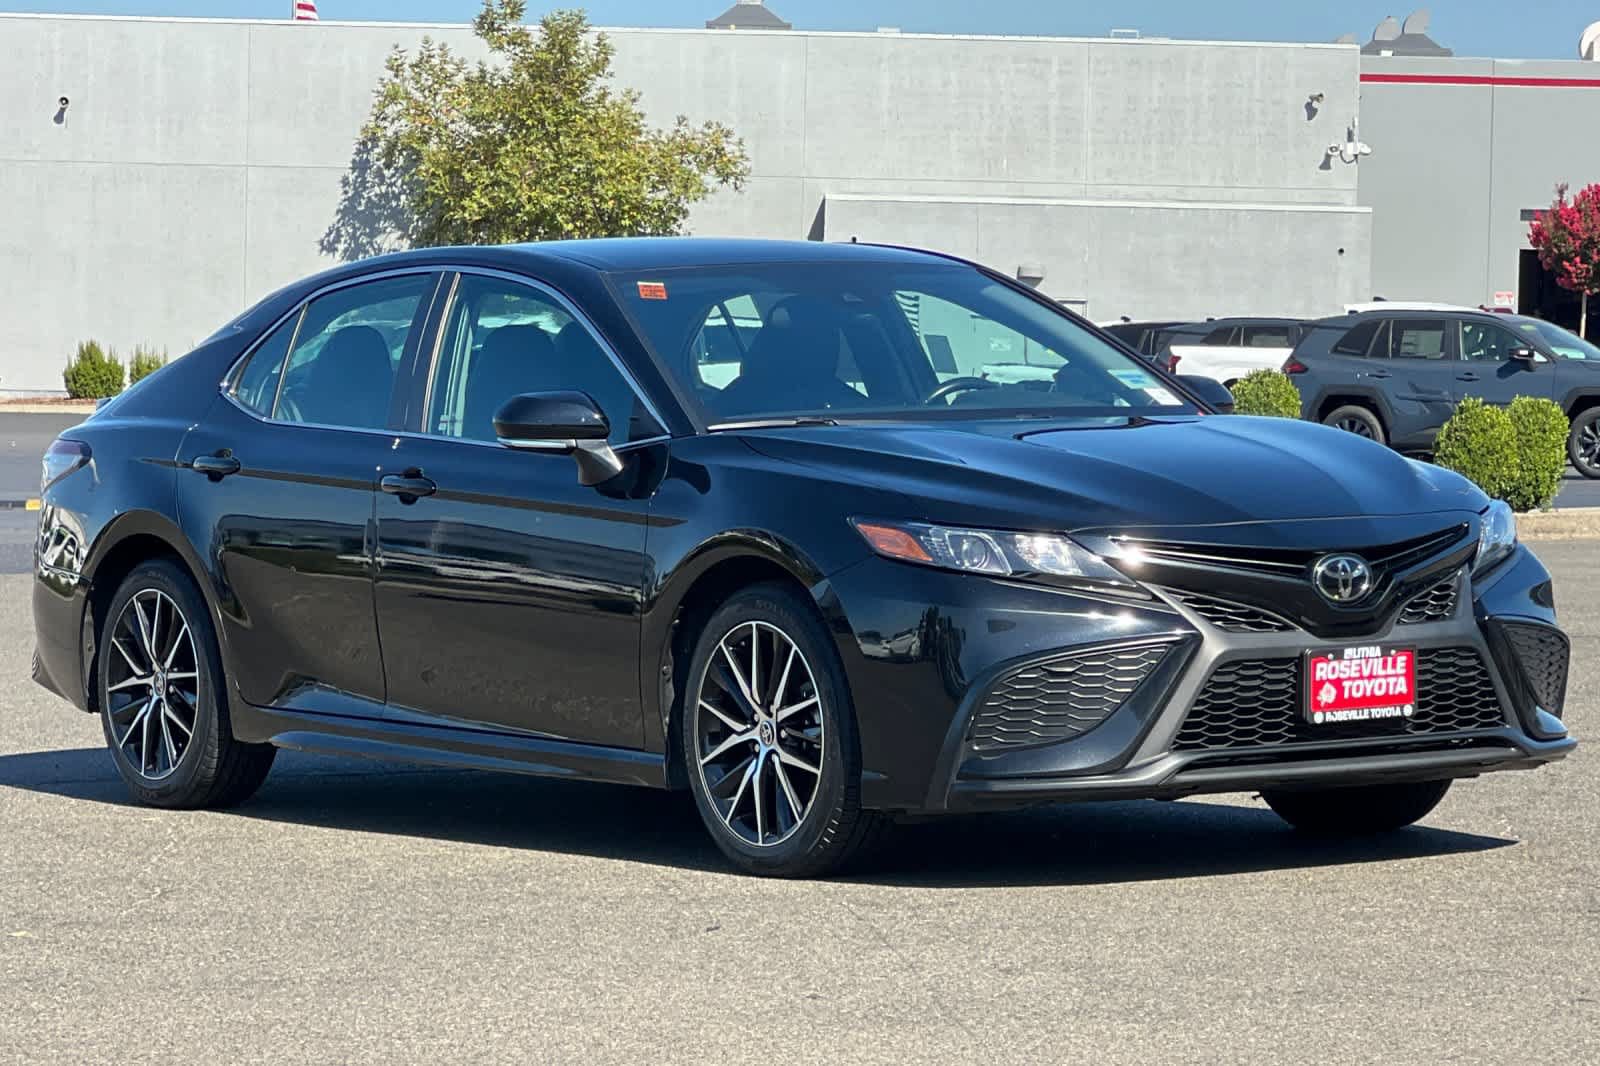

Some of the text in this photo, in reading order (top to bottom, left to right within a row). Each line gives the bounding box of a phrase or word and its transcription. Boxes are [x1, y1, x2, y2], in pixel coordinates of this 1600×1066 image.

[1315, 656, 1407, 681] ROSEVILLE
[1342, 677, 1408, 699] TOYOTA
[1326, 706, 1401, 722] ROSEVILLE TOYOTA
